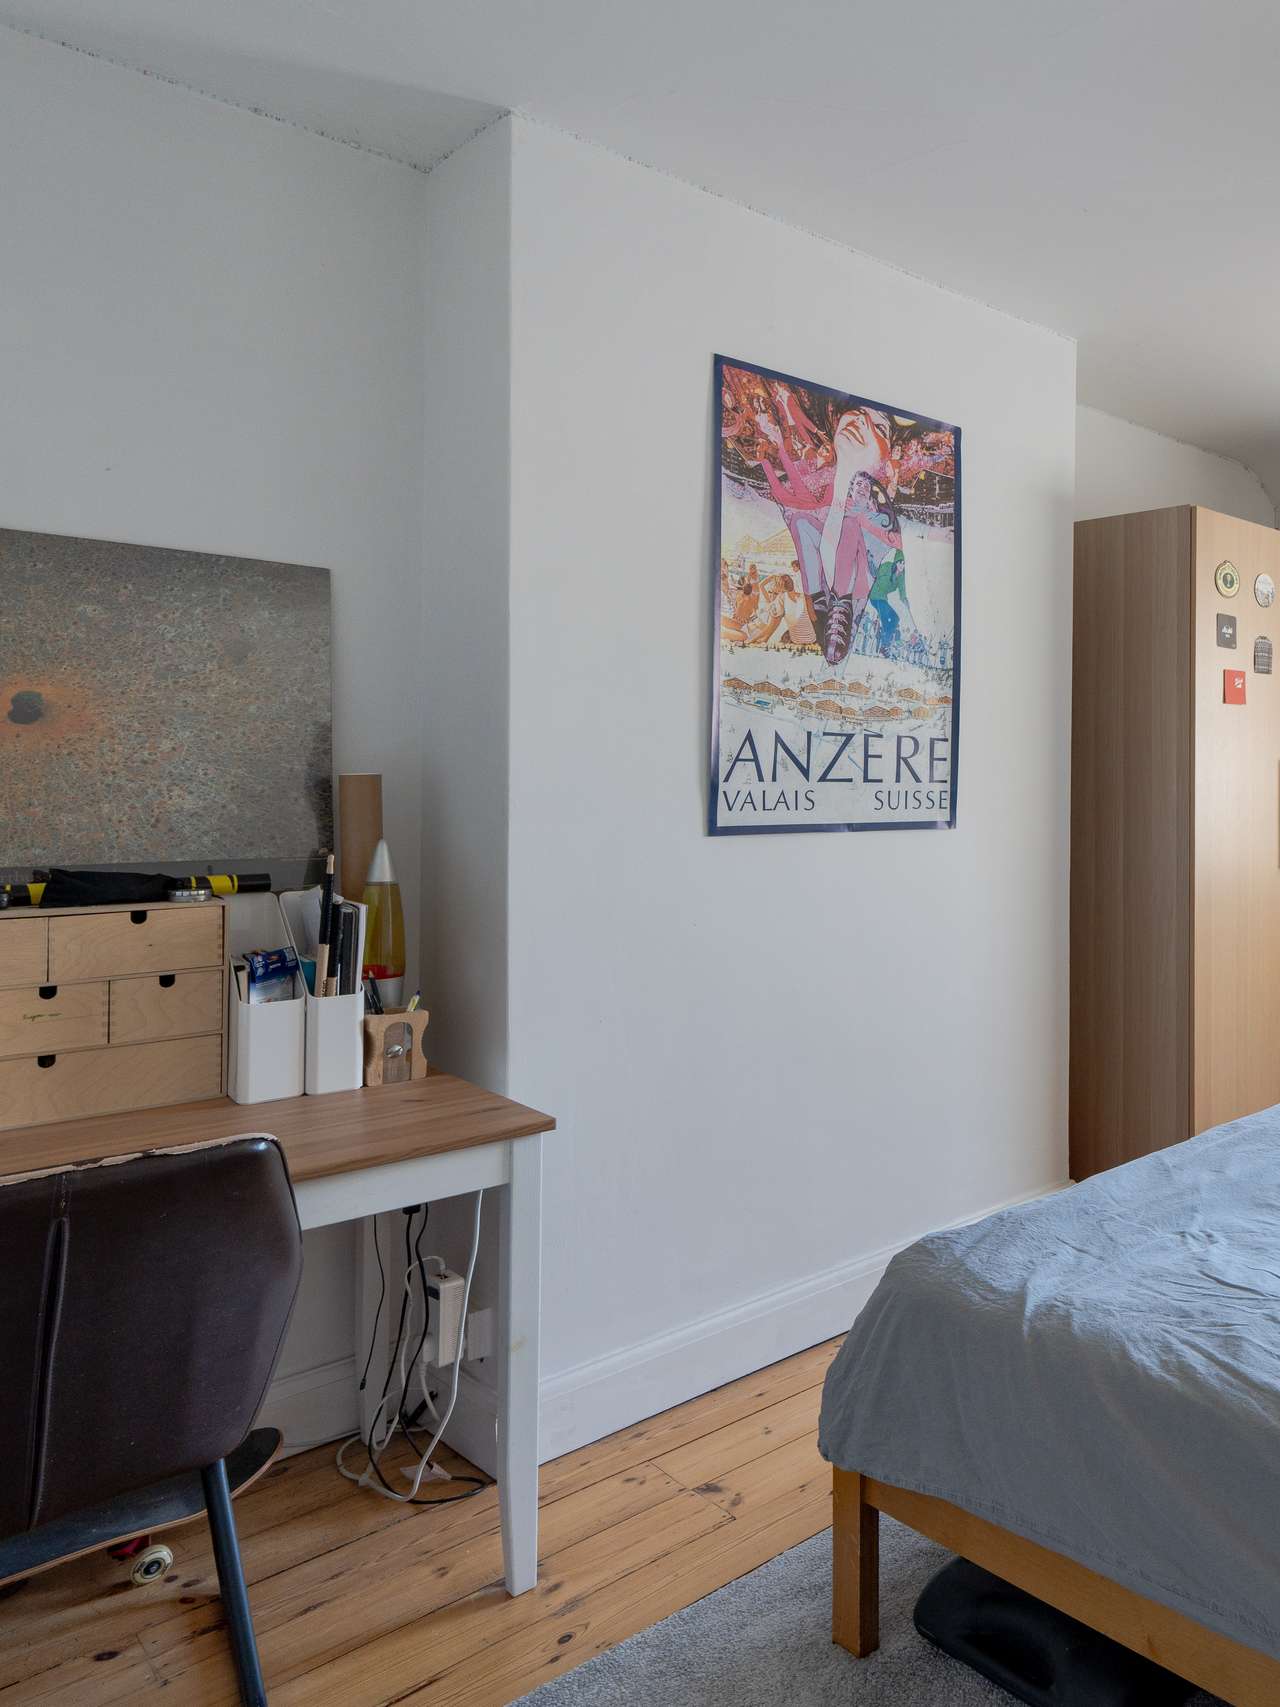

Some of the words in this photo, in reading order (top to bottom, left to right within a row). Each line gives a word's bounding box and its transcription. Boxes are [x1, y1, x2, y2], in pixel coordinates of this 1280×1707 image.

[722, 728, 949, 784] ANZÈRE
[722, 789, 816, 811] VALAIS
[874, 789, 948, 811] SUISSE
